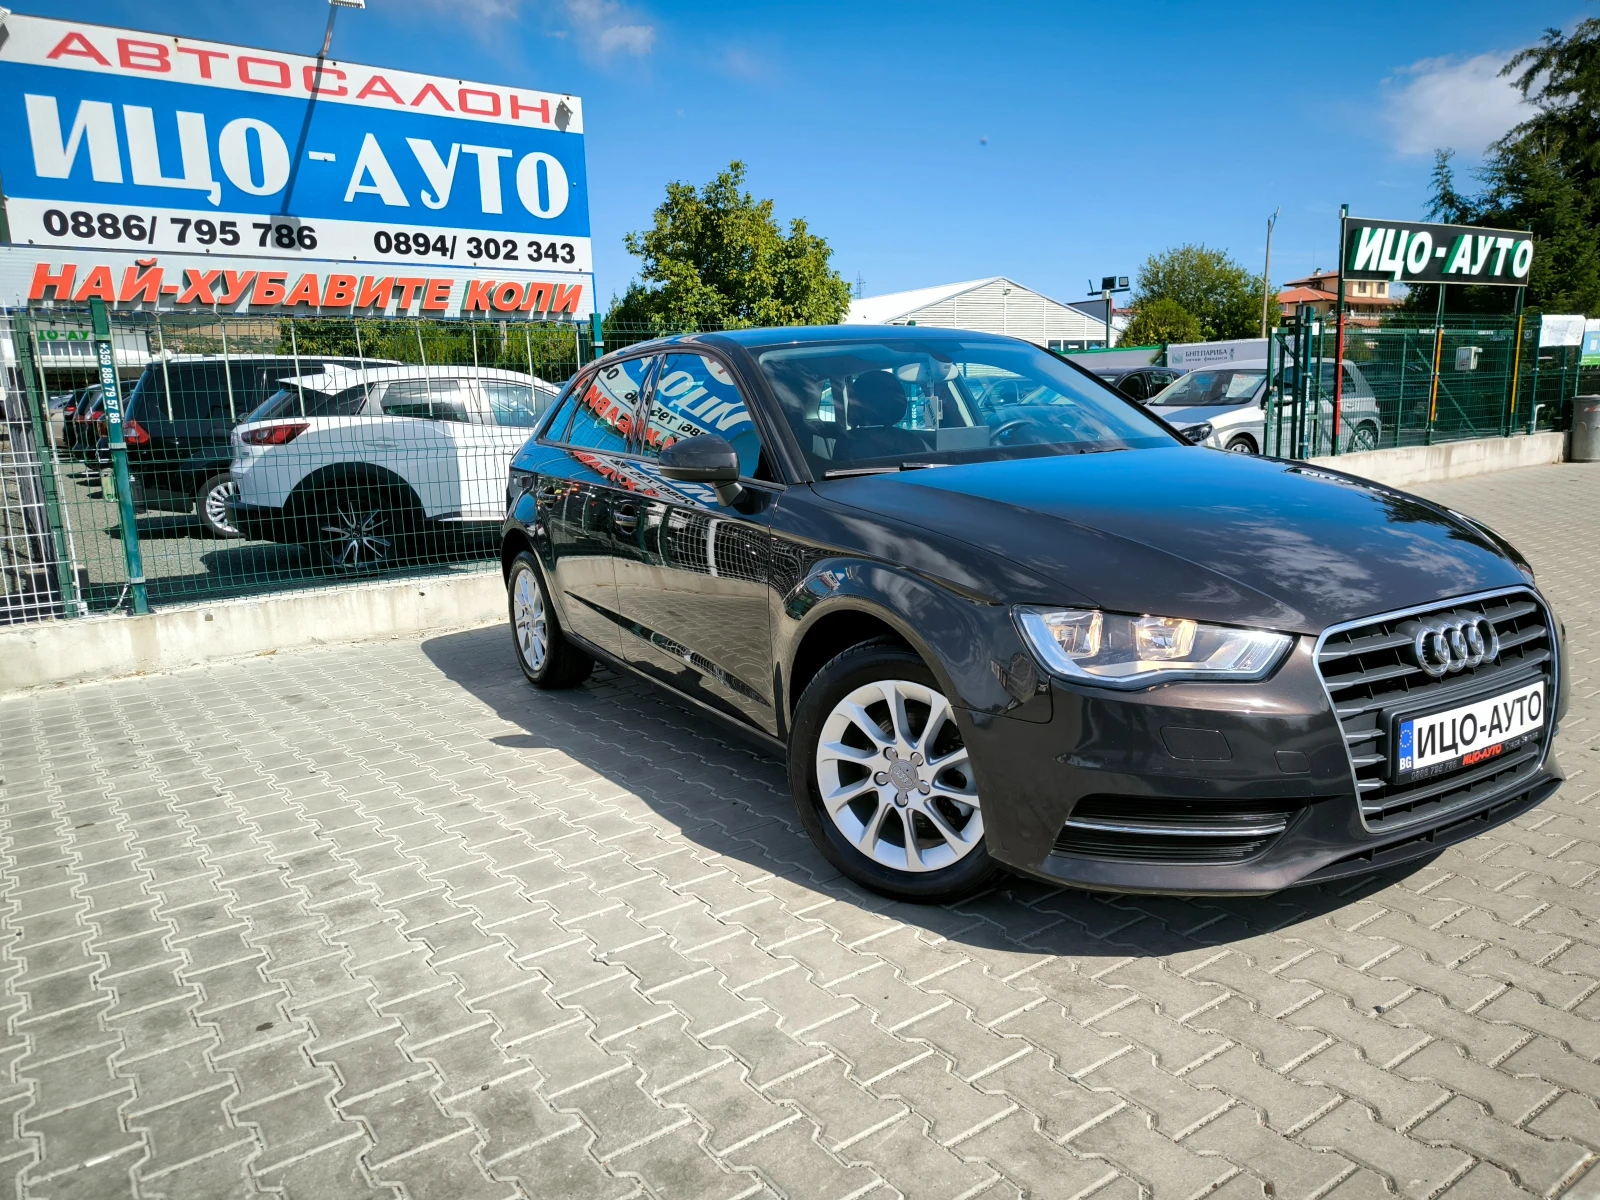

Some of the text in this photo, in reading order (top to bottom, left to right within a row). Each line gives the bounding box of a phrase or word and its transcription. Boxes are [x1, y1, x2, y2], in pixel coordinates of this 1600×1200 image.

[47, 31, 551, 124] АВТОСАЛОН
[43, 208, 318, 250] 0886/ 795 786
[374, 230, 576, 264] 0894/ 302 343
[27, 256, 583, 314] НАЙ-ХУБАВИТЕ КОЛИ
[99, 342, 121, 424] +359 886 79 57 86
[1416, 690, 1543, 759] ИЦО-АУТО
[1399, 756, 1412, 771] BG
